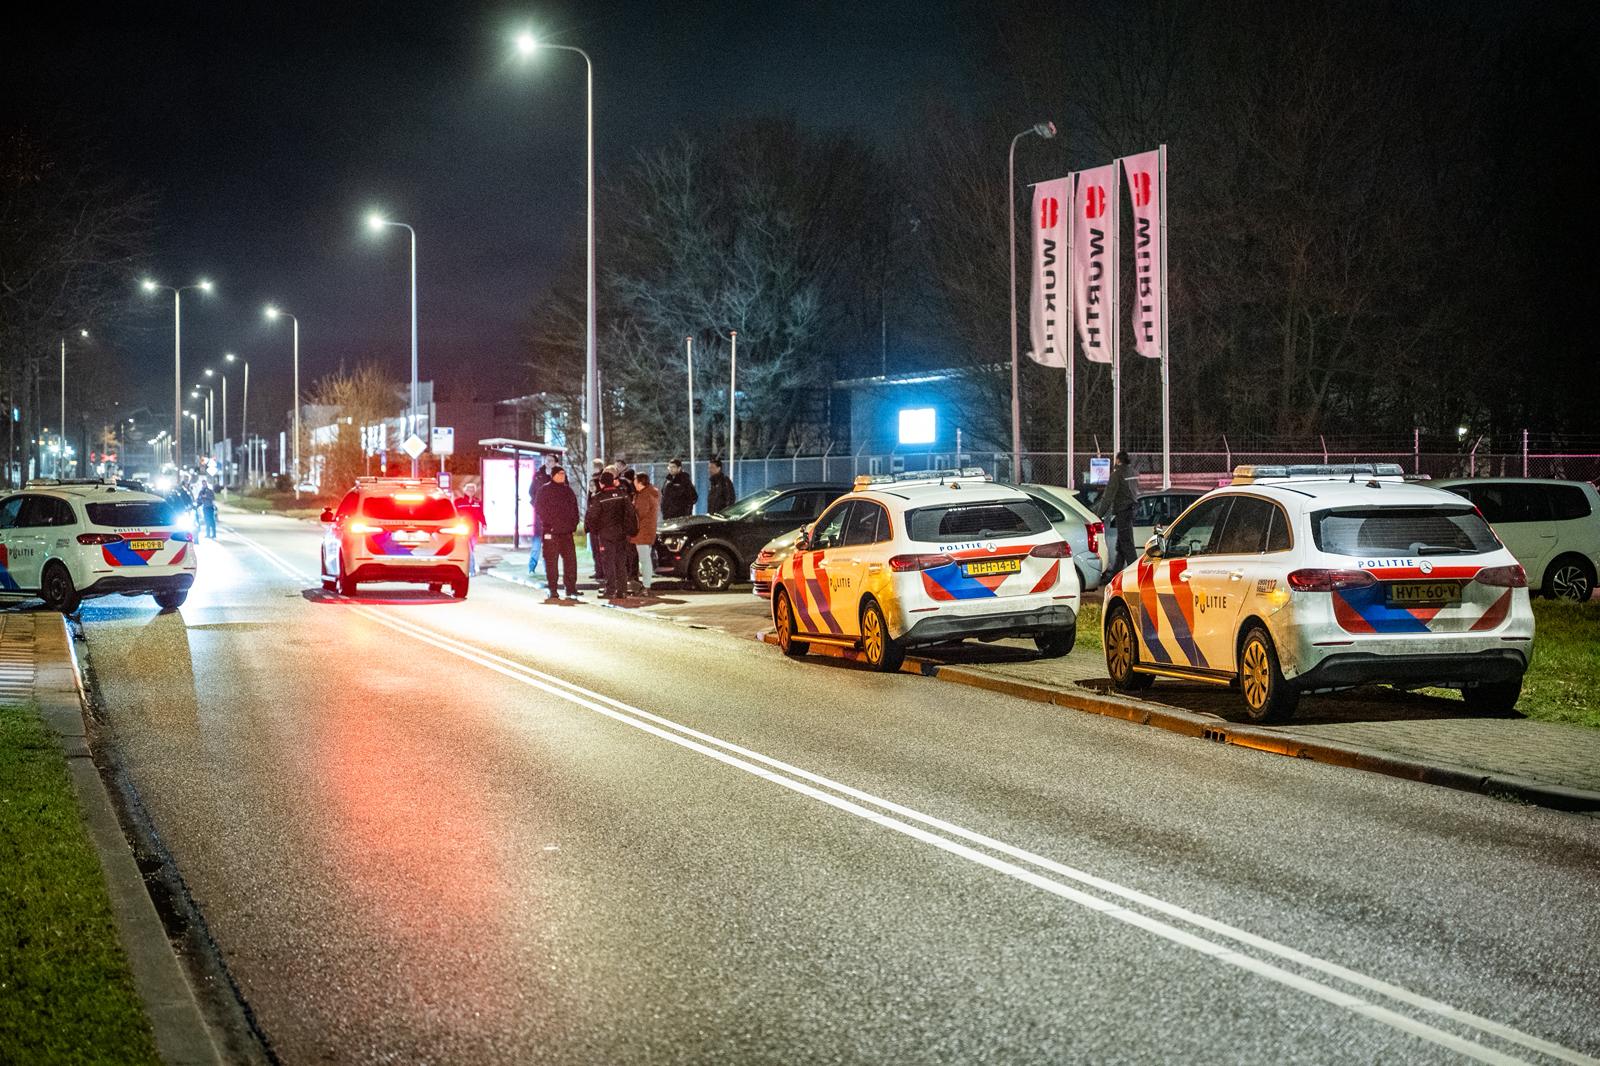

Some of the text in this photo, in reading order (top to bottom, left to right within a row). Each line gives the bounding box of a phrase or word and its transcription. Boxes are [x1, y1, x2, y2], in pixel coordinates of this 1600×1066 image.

[939, 542, 982, 552] POLITIE
[972, 560, 1017, 573] HFH-14-B
[1358, 559, 1414, 568] POLITIE
[1396, 585, 1456, 598] HVT-60-V
